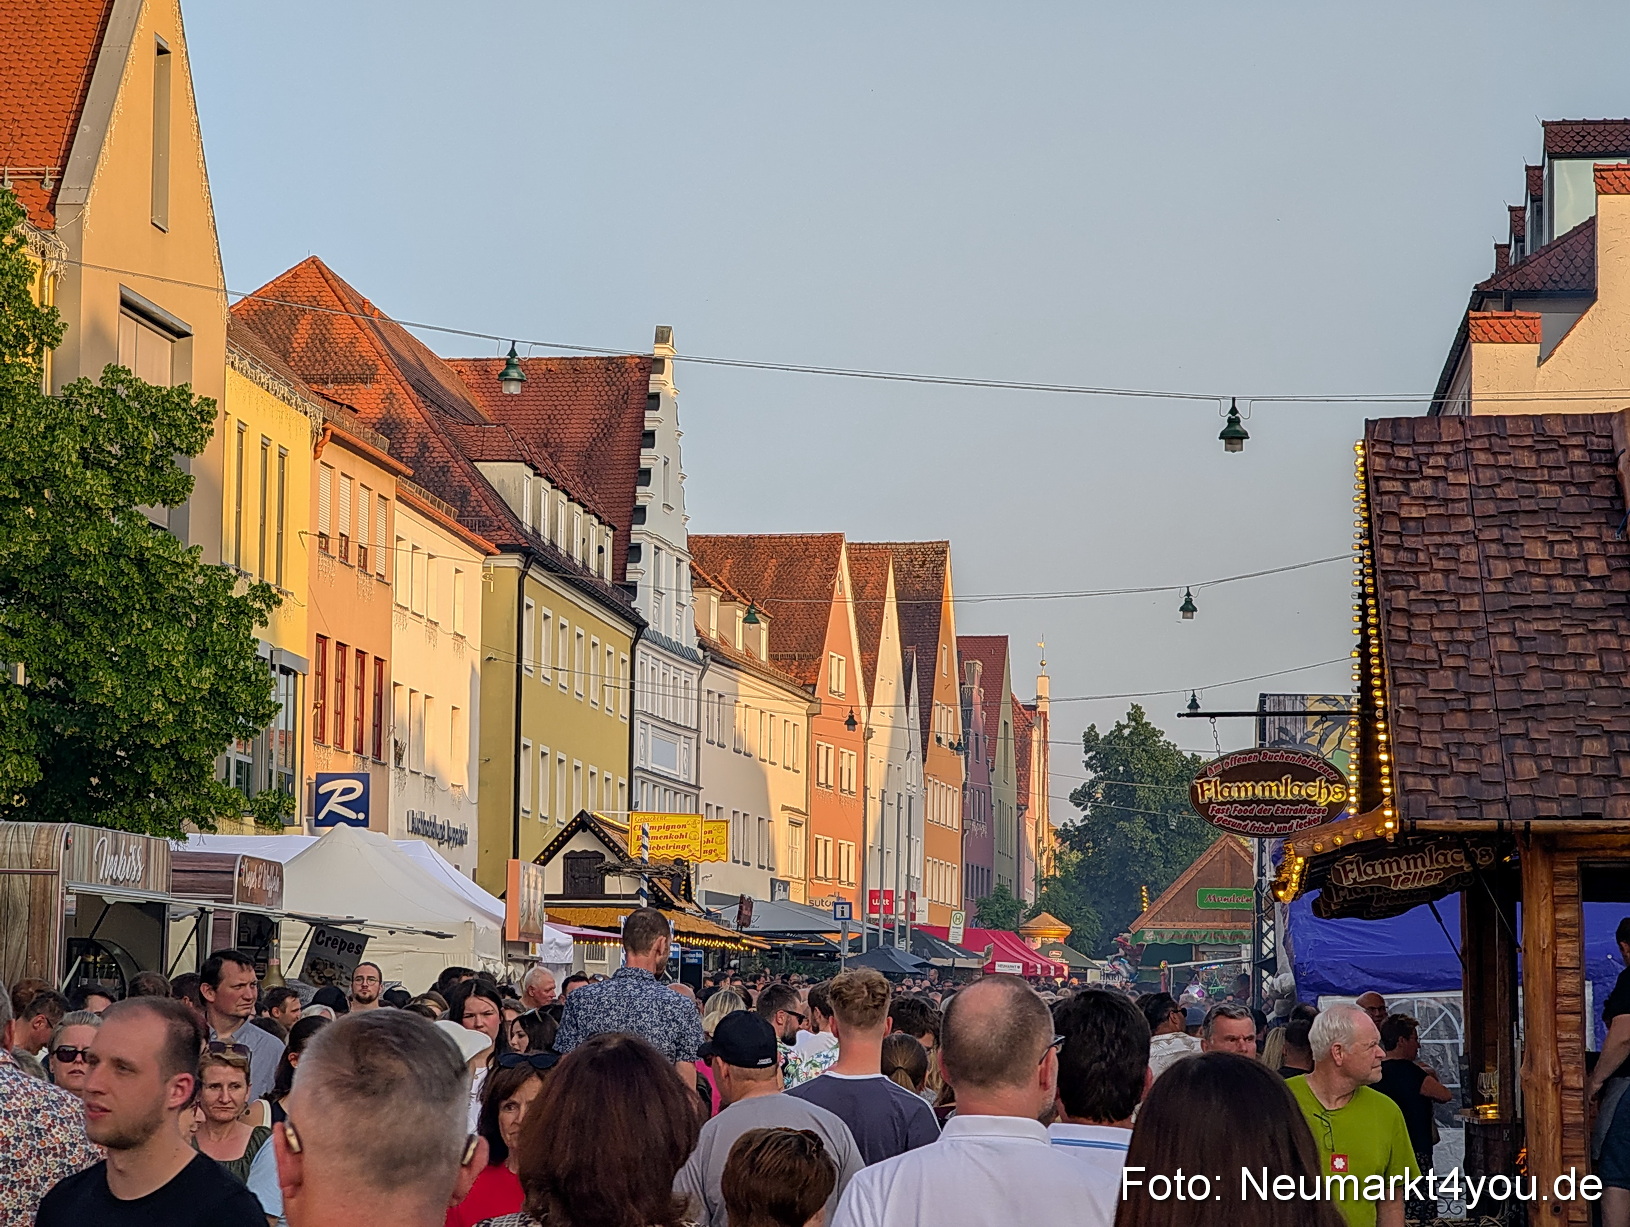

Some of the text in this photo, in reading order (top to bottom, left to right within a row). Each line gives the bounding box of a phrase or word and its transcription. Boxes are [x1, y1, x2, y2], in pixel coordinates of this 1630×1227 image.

[1207, 750, 1338, 781] Am offenen Buchenholzfeuer
[1195, 774, 1347, 806] Flammlachs
[1209, 805, 1328, 815] Fast Food der Extraklasse
[1215, 815, 1322, 834] gesund frisch und lecker
[94, 837, 145, 882] Imbiss
[637, 844, 691, 852] Ziebelringe
[1336, 842, 1494, 885] Flammlacs
[1391, 871, 1444, 890] Teller
[314, 929, 363, 955] Crêpes
